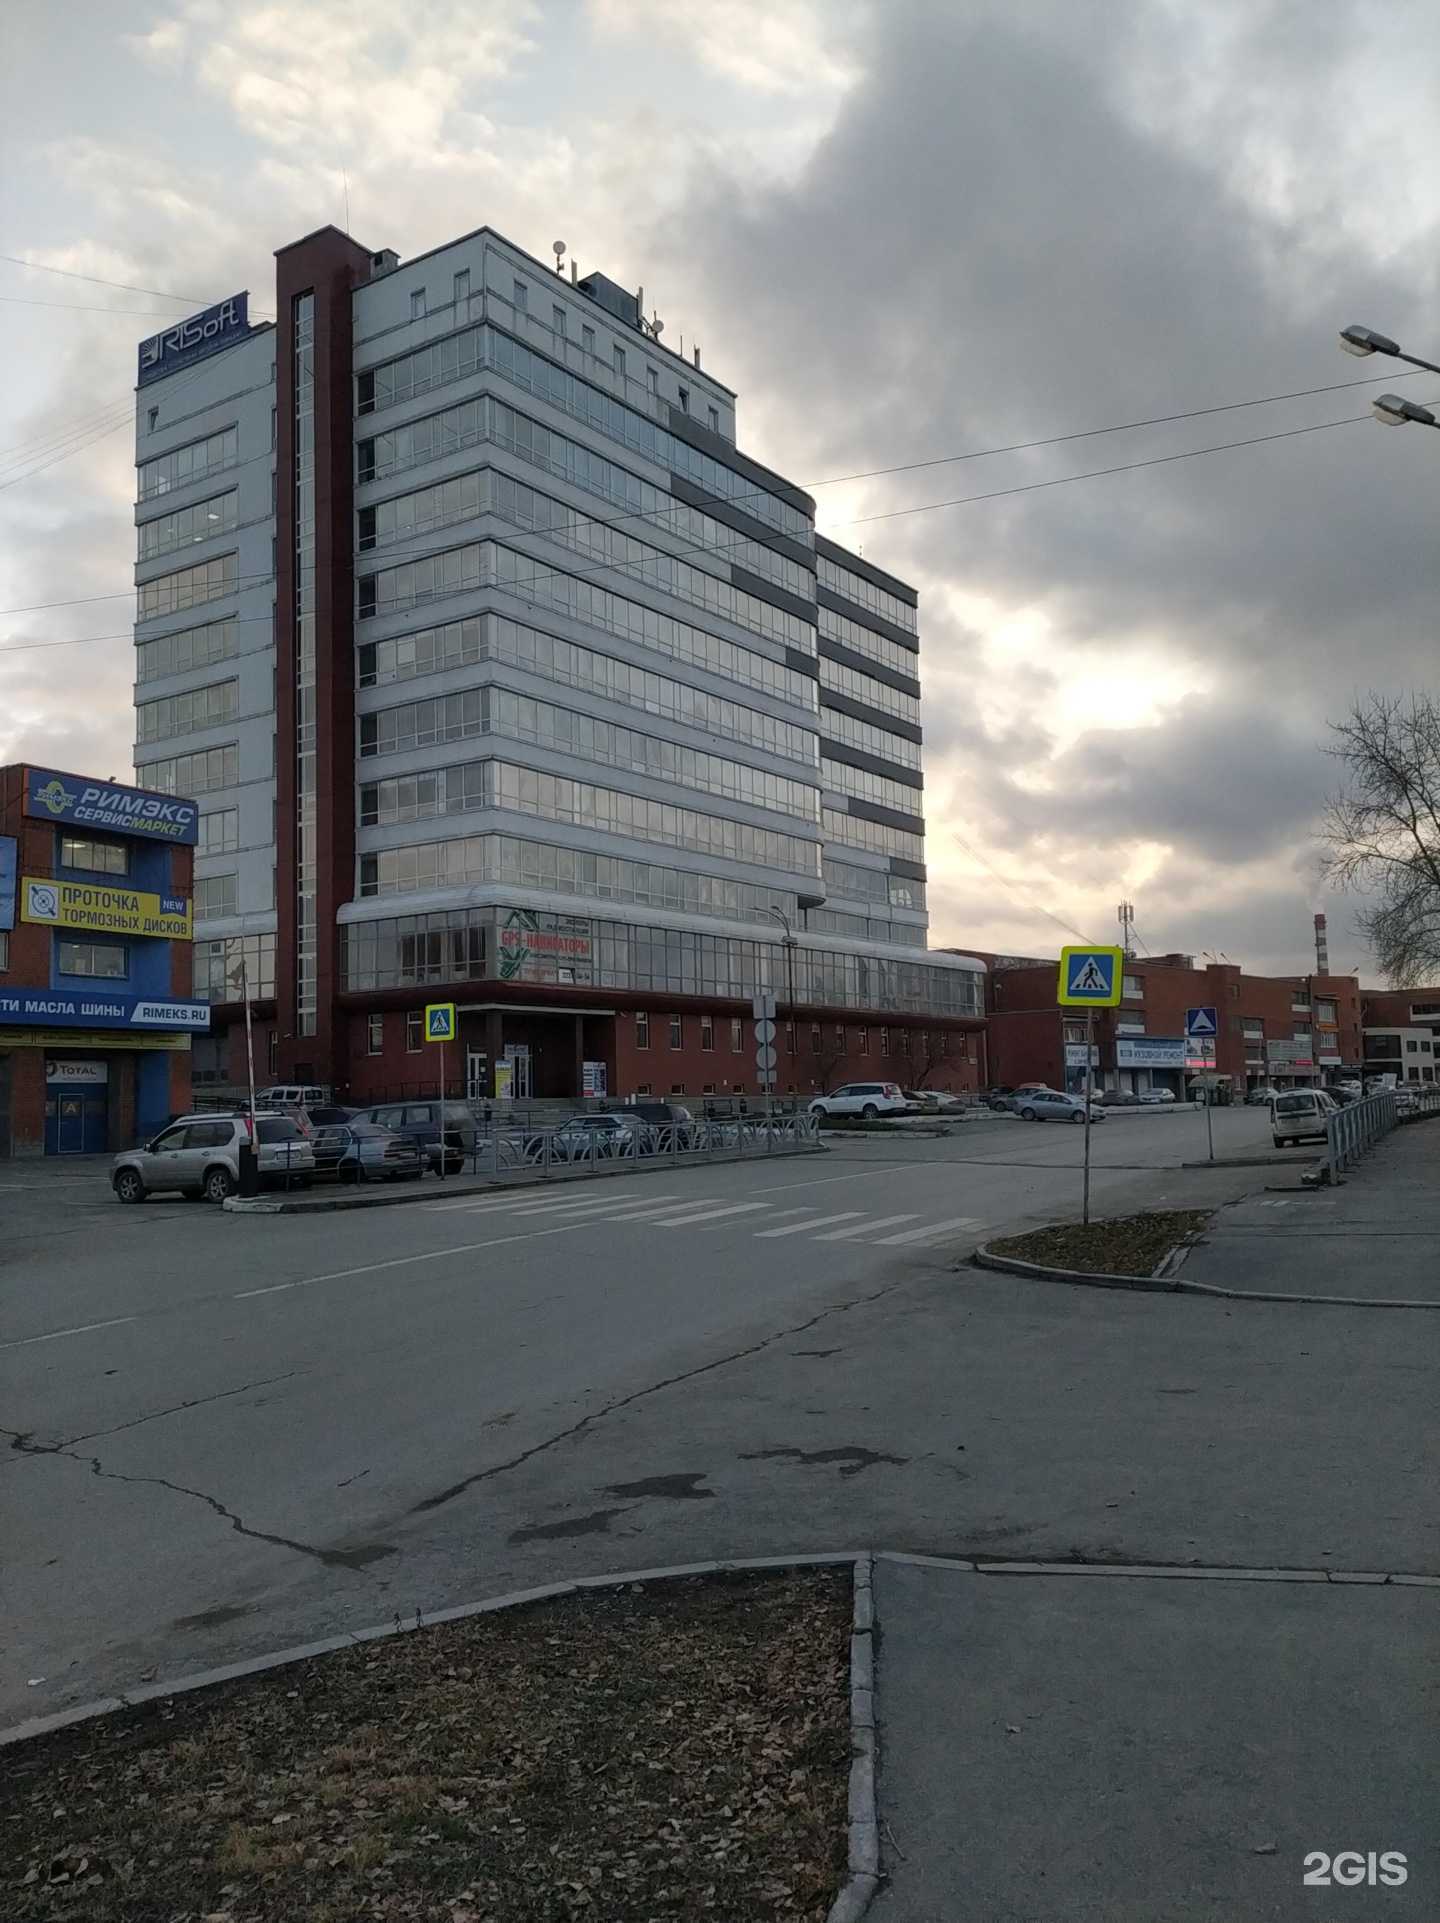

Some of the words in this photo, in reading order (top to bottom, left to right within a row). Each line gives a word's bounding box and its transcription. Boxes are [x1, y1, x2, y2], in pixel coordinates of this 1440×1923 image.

[80, 788, 194, 823] РИМЭКС
[74, 806, 187, 836] СЕРВИСМАРКЕТ
[62, 887, 139, 912] ПРОТОЧКА
[163, 900, 183, 911] NEW
[63, 908, 139, 929] ТОРМОЗНЫХ
[143, 919, 187, 934] ДИСКОВ
[0, 999, 19, 1012] ТИ
[25, 1001, 75, 1015] МАСЛА
[81, 1003, 124, 1017] ШИНЫ
[142, 1007, 206, 1020] RIMEKS.RU
